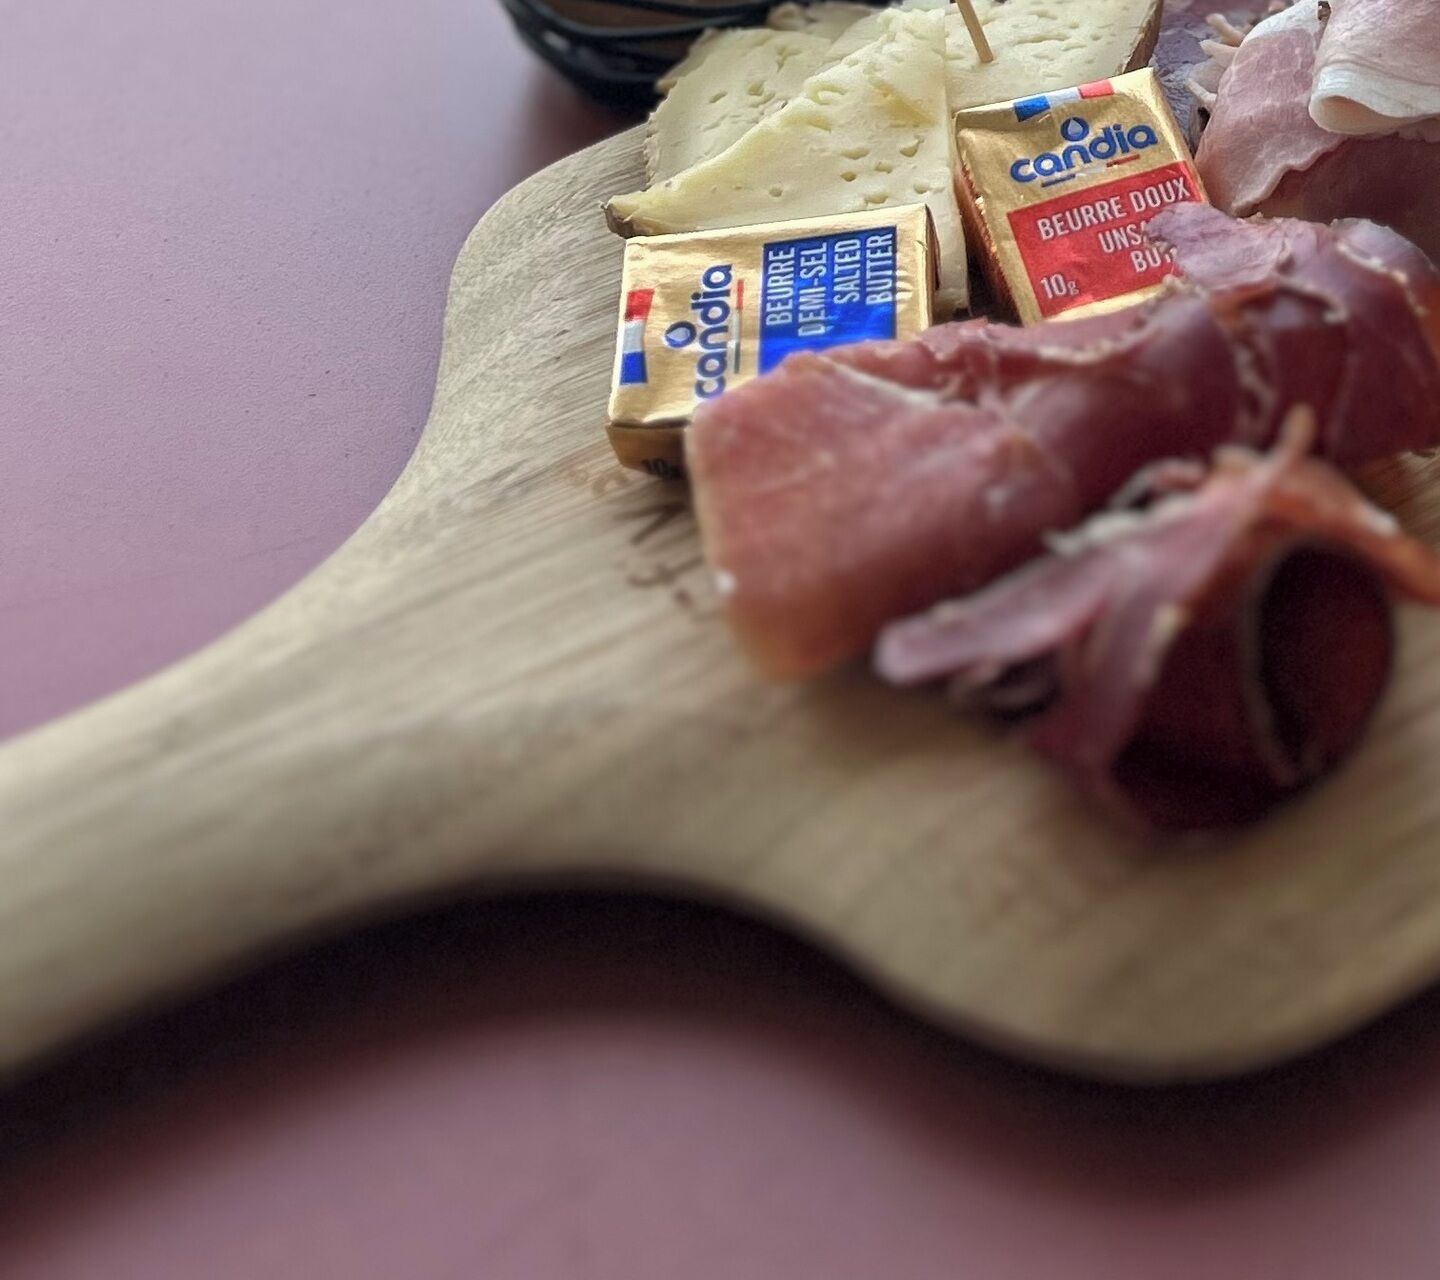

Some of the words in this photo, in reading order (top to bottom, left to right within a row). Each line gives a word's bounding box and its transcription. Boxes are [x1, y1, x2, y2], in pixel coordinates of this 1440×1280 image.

[1010, 124, 1158, 183] candia
[1036, 196, 1127, 241] BEURRE
[1129, 177, 1191, 213] DOUX
[765, 246, 796, 326] BEURRE
[798, 242, 828, 337] DEMI-SEL
[833, 238, 861, 305] SALTED
[866, 232, 894, 306] BUTTER
[1039, 273, 1080, 299] 10g
[1130, 246, 1171, 273] BU
[691, 263, 733, 400] candia
